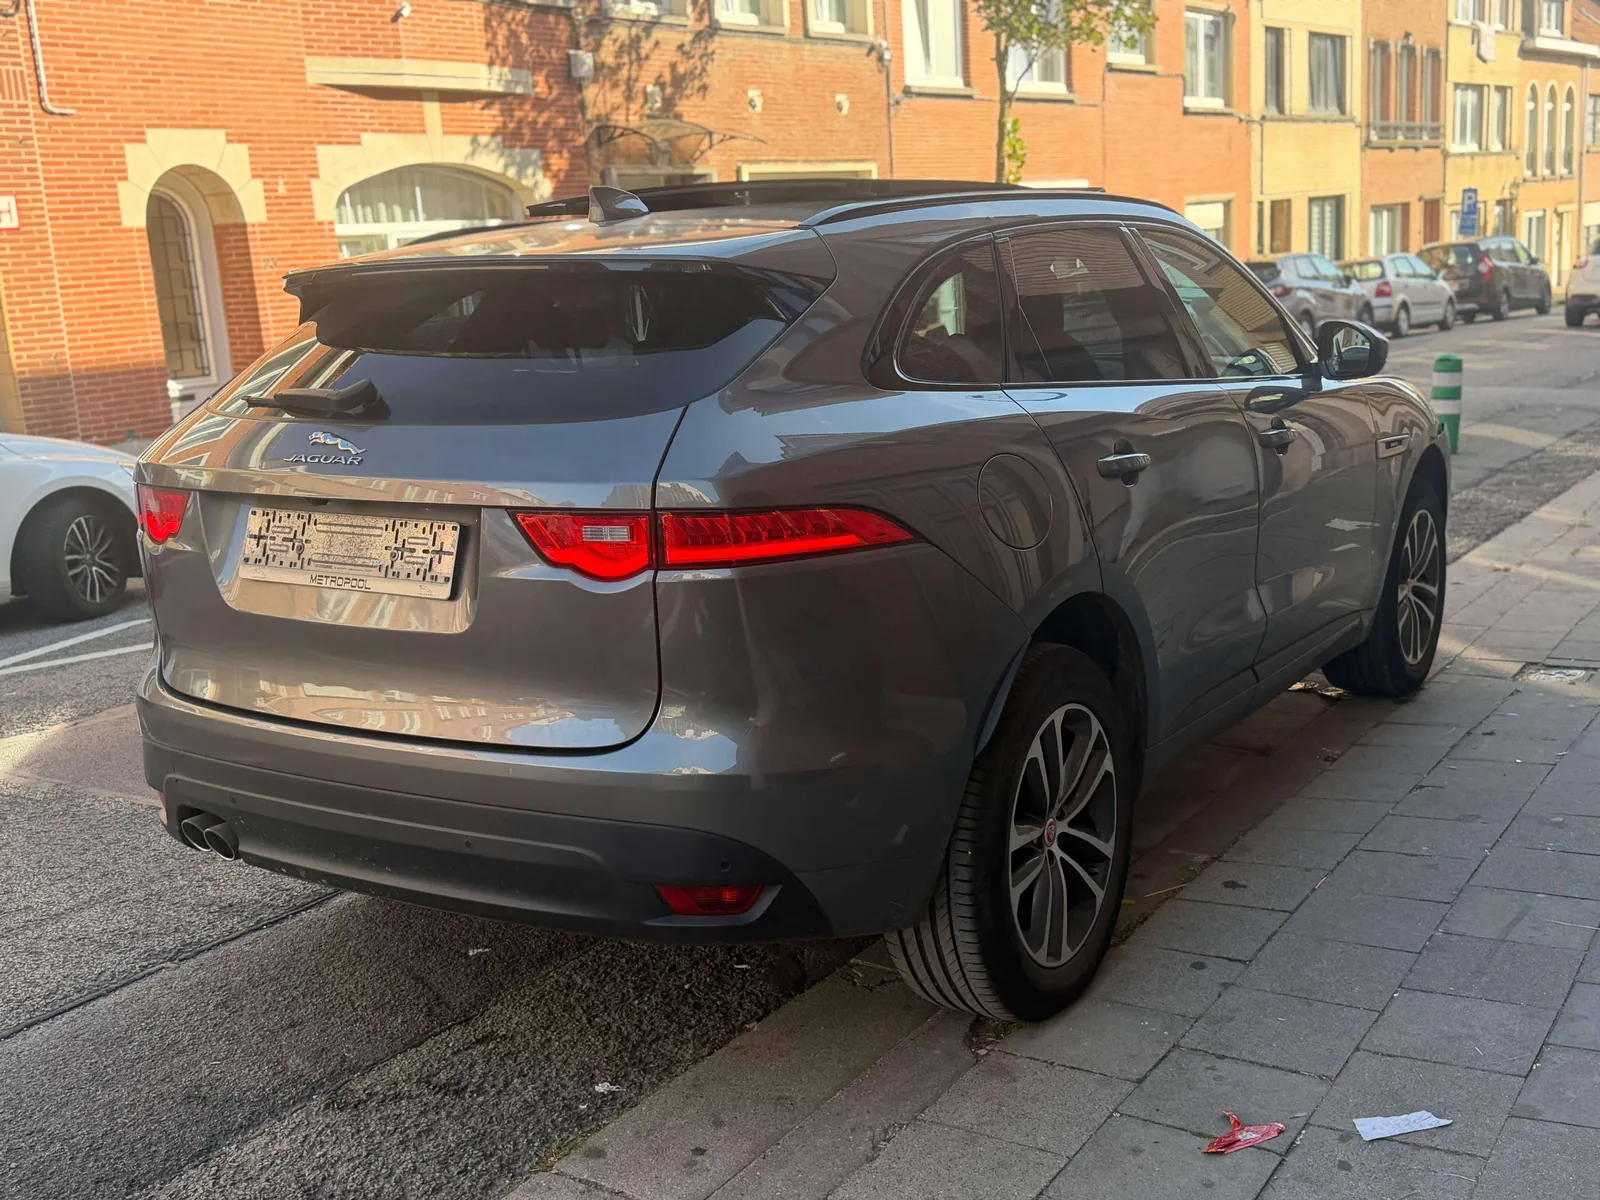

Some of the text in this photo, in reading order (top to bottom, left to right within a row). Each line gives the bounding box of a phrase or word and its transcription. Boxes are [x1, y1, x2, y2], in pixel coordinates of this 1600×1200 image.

[1463, 191, 1476, 212] P
[283, 454, 362, 465] JAGUAR
[309, 574, 371, 590] METROPOOL
